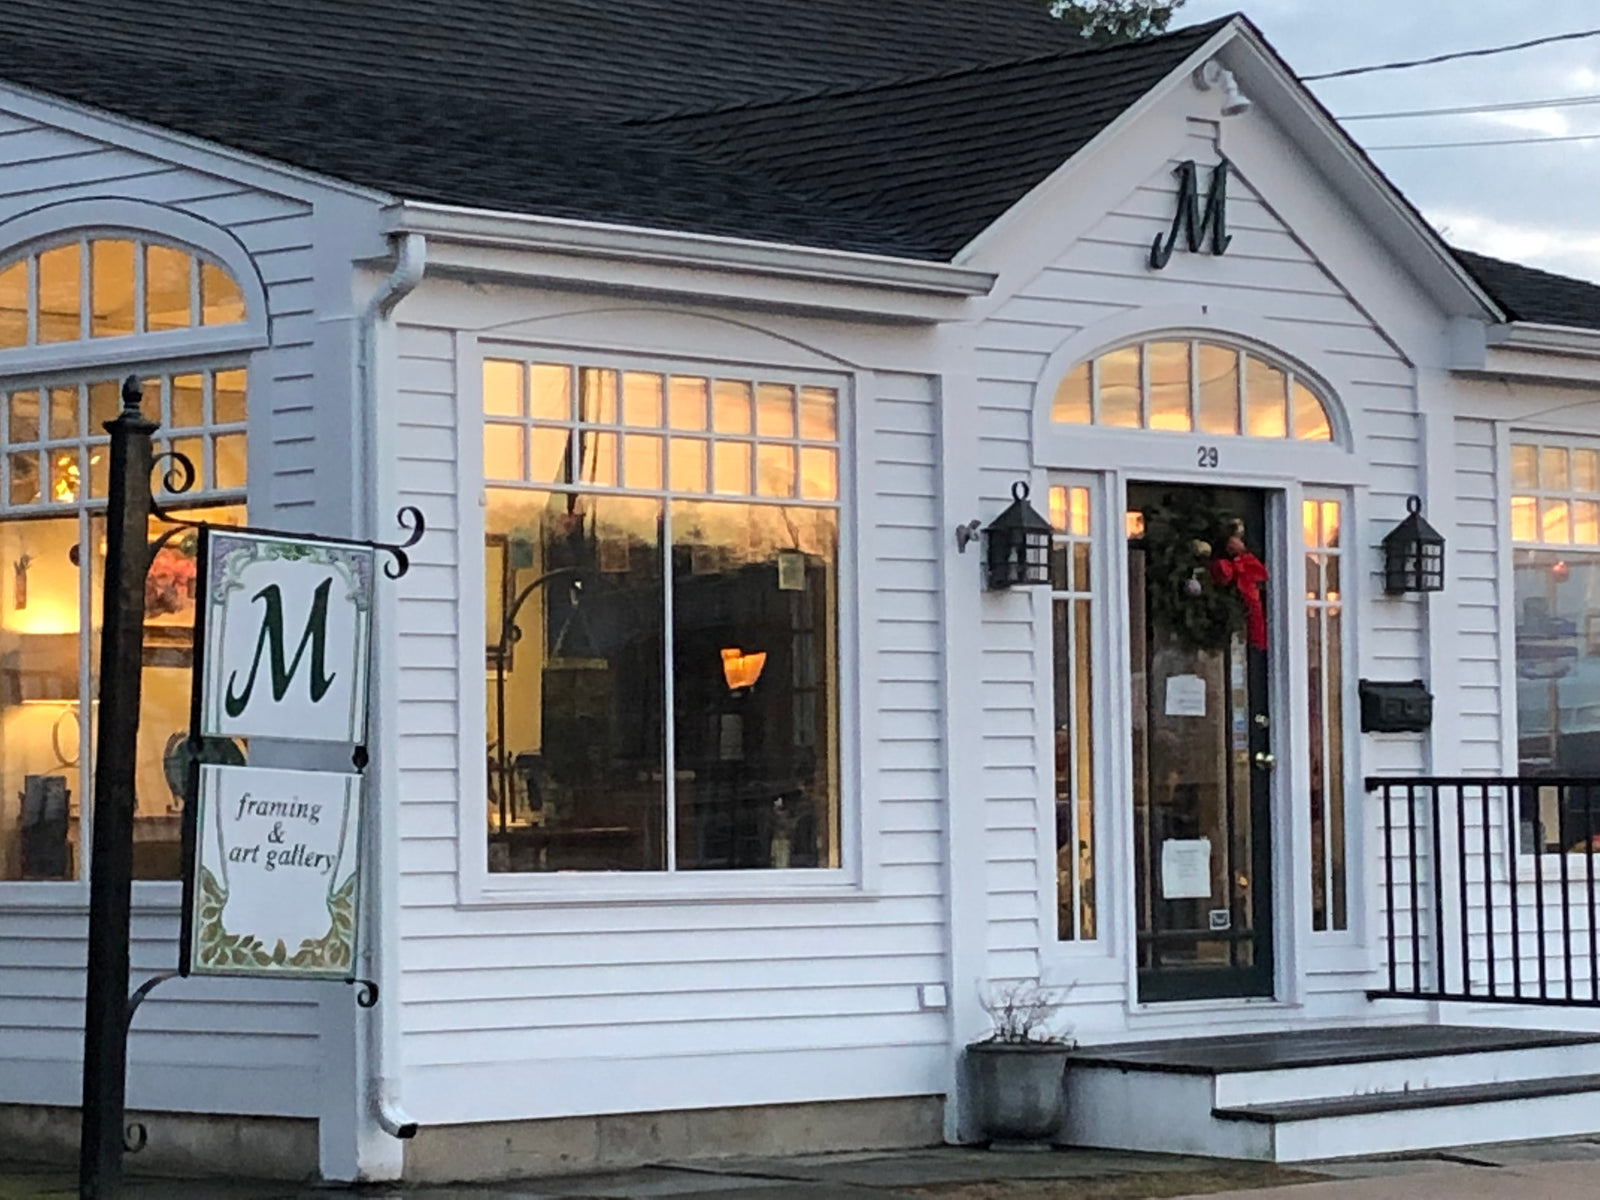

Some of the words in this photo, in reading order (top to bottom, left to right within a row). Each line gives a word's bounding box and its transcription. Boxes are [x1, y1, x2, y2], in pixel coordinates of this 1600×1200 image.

[1150, 160, 1232, 270] M
[1198, 446, 1218, 468] 29
[225, 577, 336, 717] M
[235, 792, 322, 824] framing
[267, 821, 285, 844] &
[229, 845, 259, 863] art
[265, 843, 336, 875] gallery
